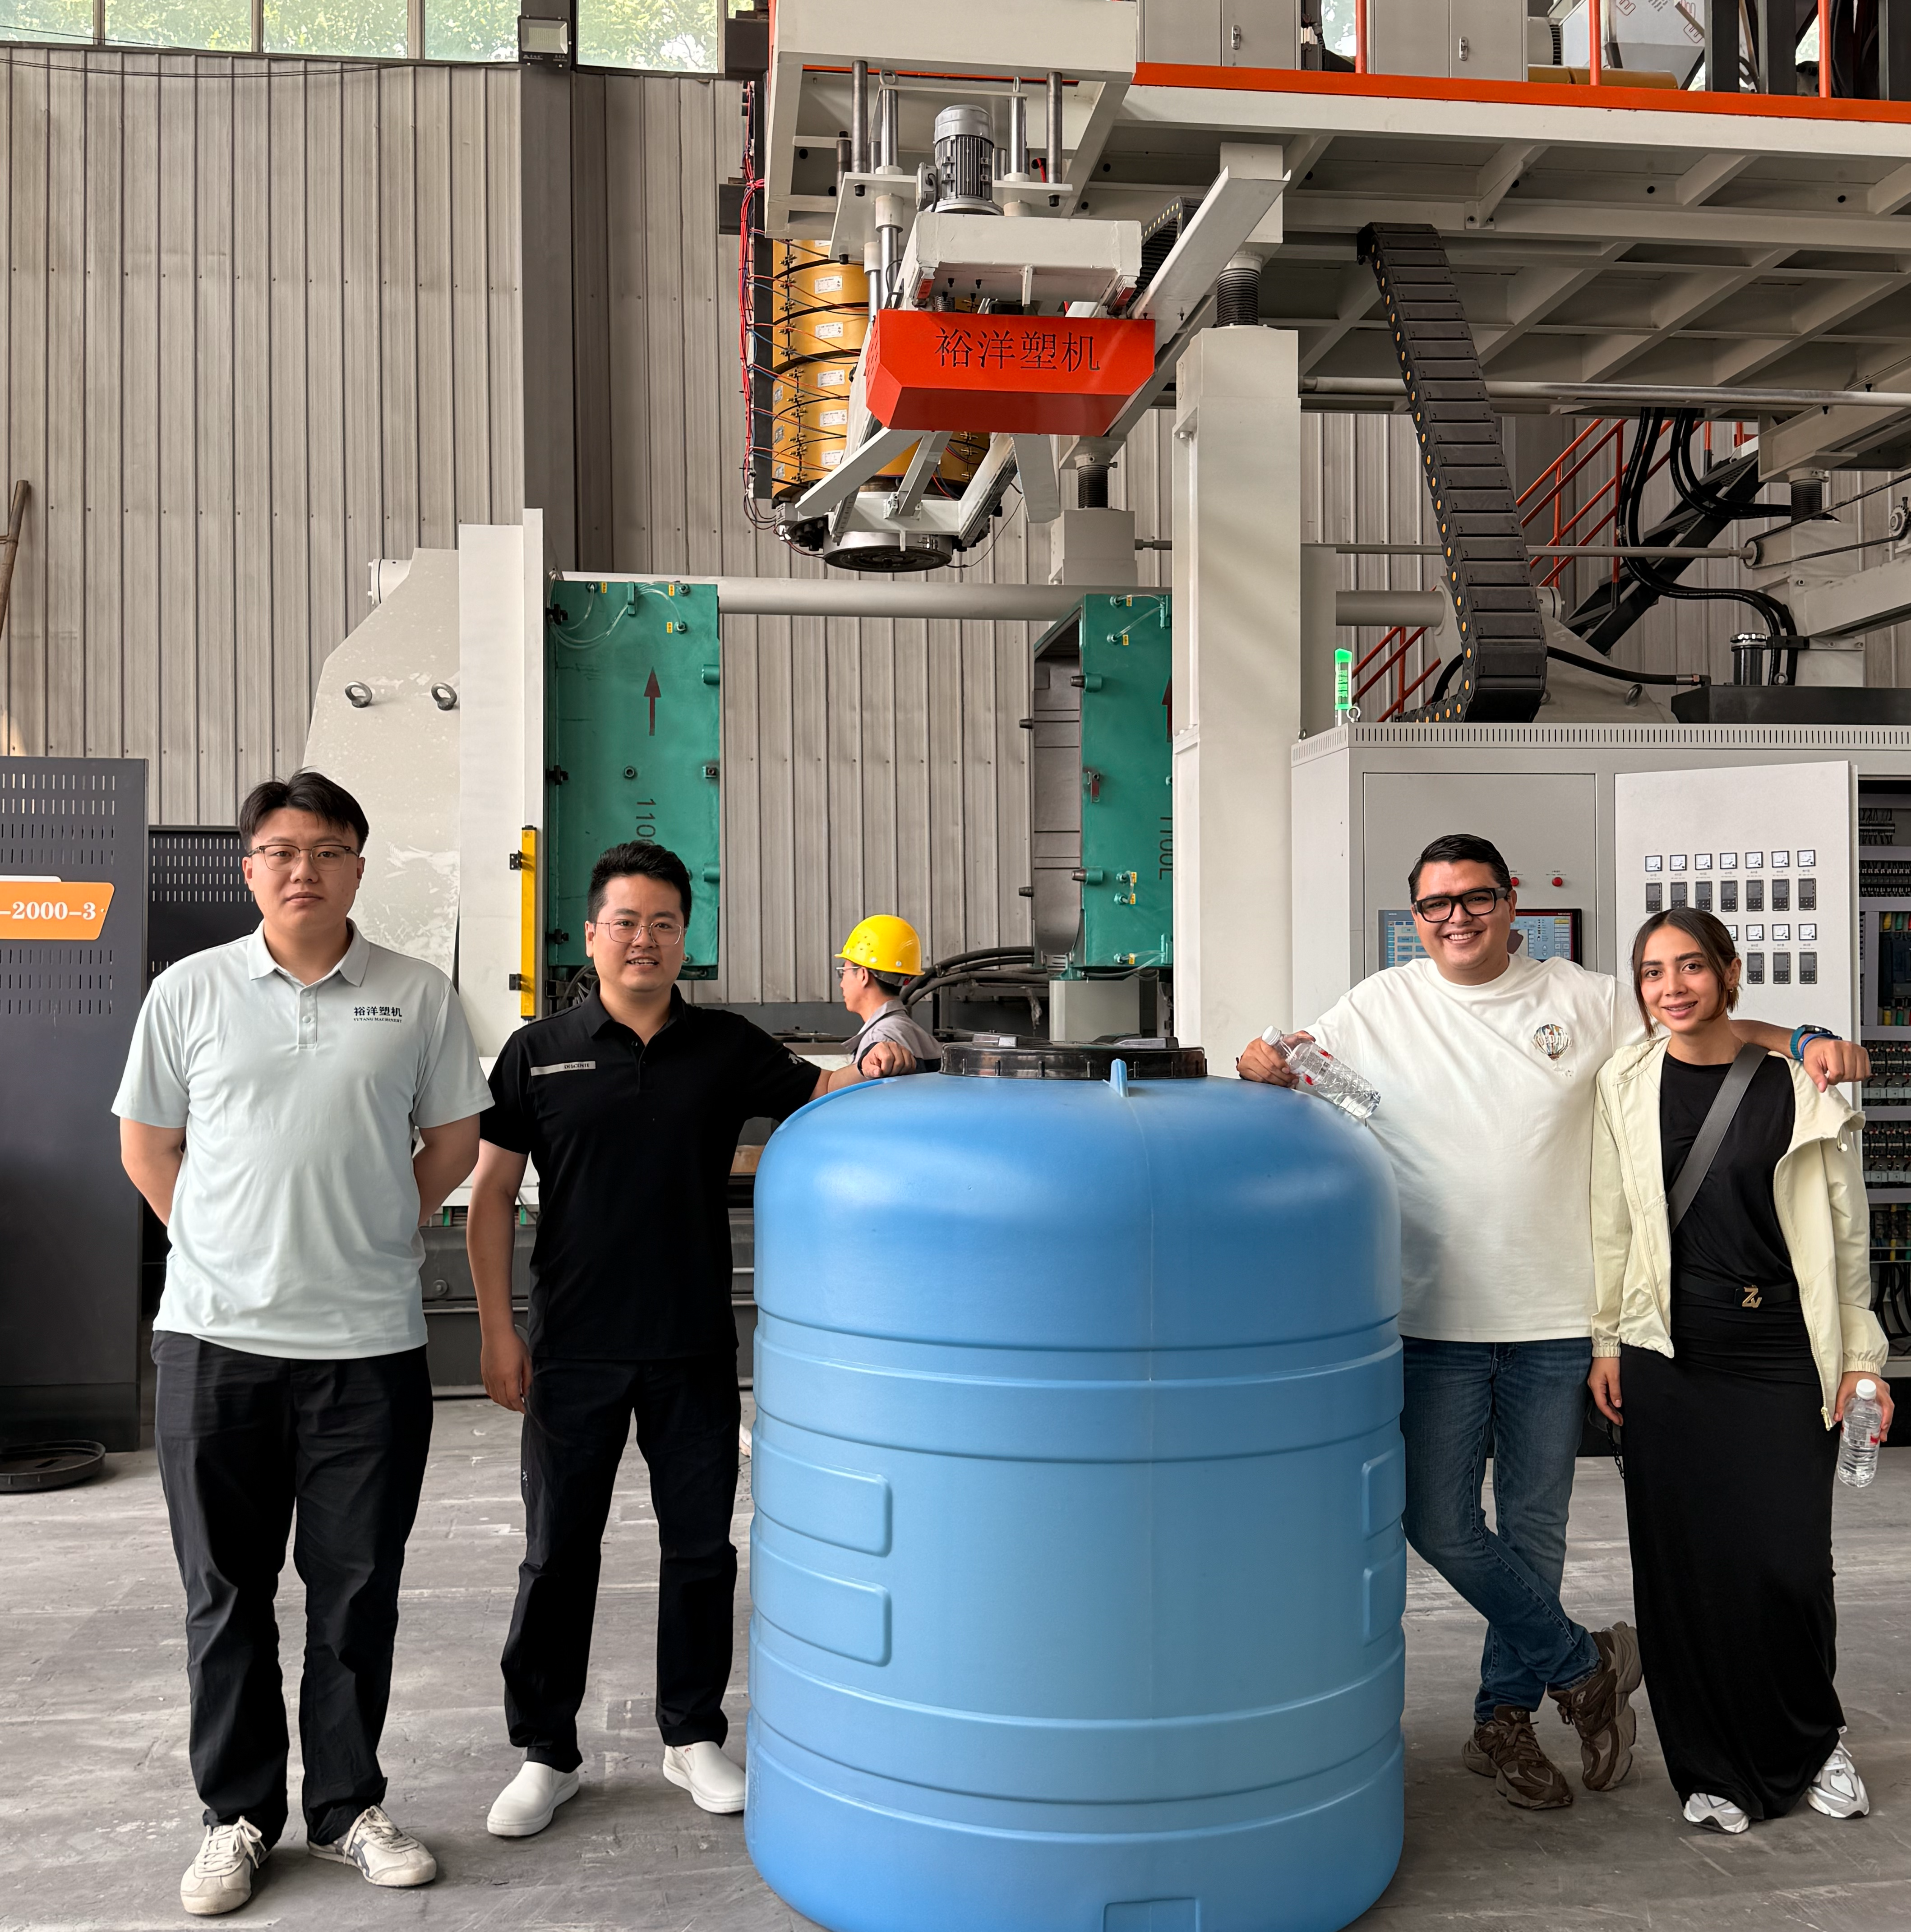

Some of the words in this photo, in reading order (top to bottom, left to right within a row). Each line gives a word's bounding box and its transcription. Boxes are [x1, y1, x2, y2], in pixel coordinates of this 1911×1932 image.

[935, 327, 1101, 372] 裕洋塑机
[354, 1006, 402, 1017] 裕洋塑机
